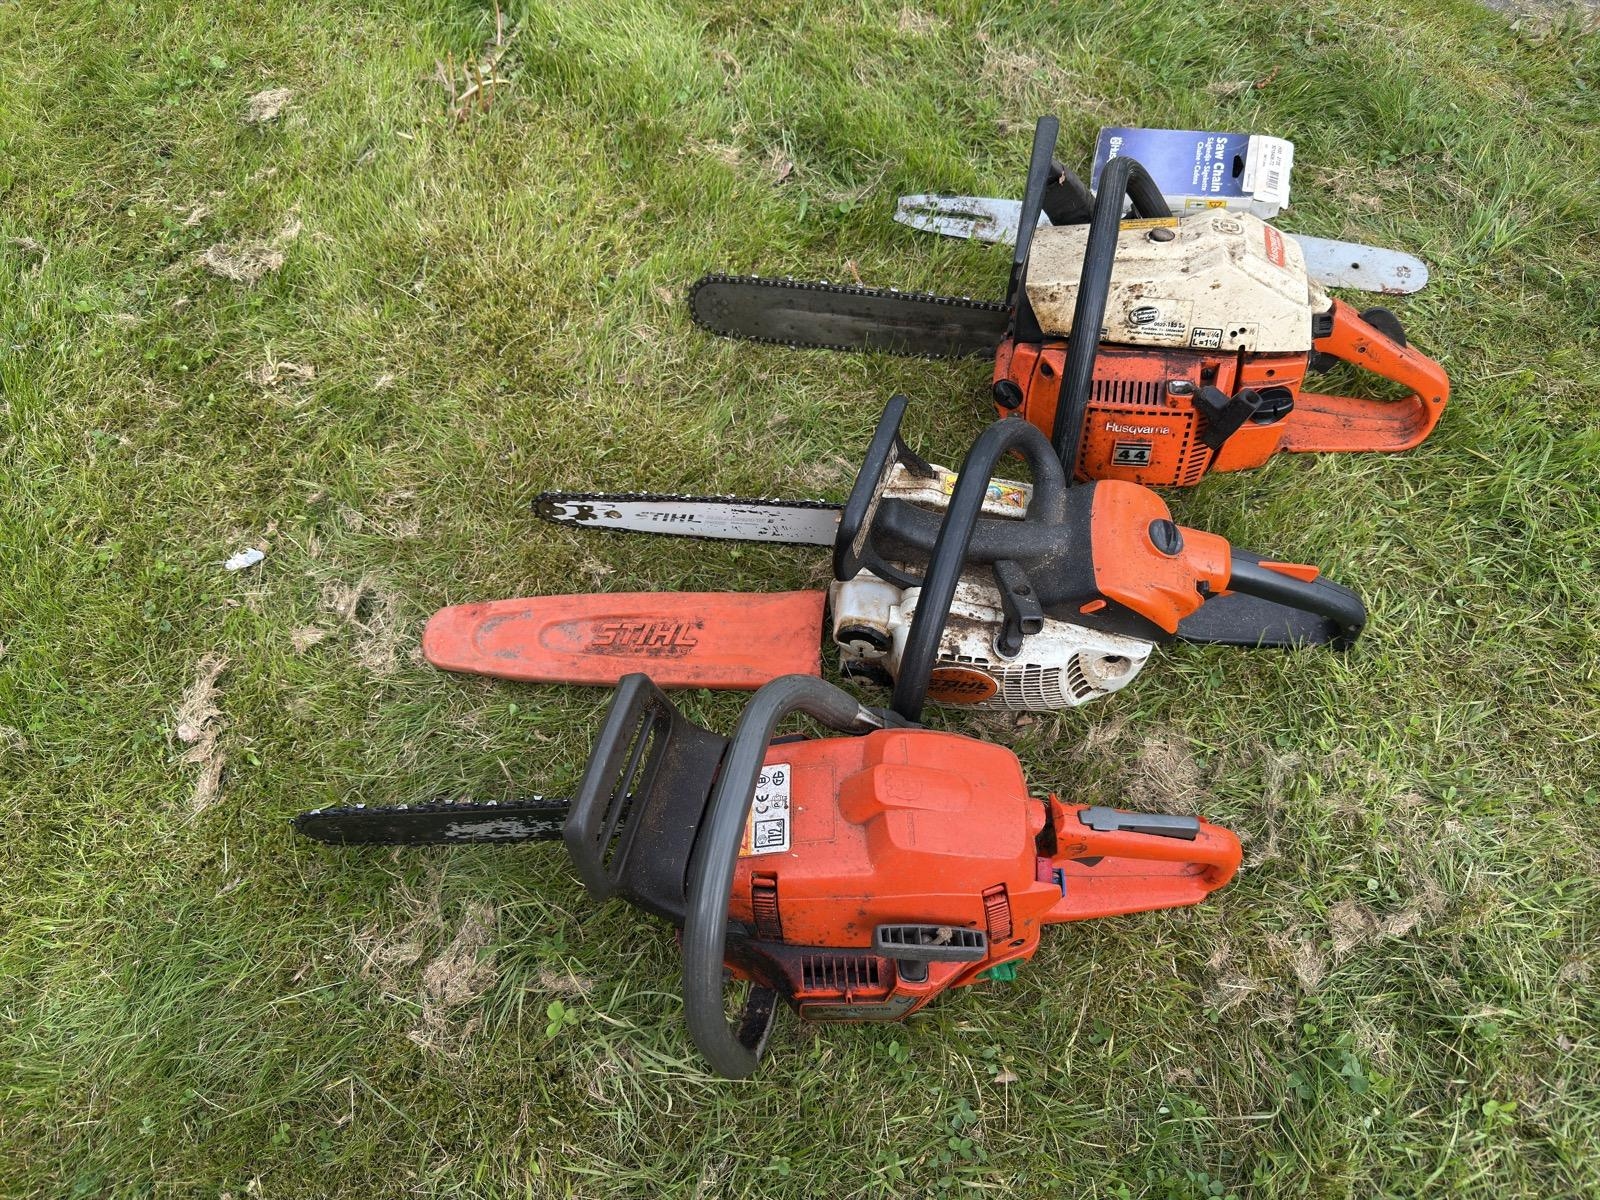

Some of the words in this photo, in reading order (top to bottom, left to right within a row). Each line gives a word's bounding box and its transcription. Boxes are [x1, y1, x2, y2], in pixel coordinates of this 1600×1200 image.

[1214, 137, 1228, 160] Saw
[1192, 165, 1201, 185] Cadena
[1211, 162, 1224, 192] Chain
[1105, 421, 1170, 435] Husqvarna
[635, 511, 702, 524] STIHL
[591, 623, 699, 647] STIHL
[767, 828, 782, 844] 112
